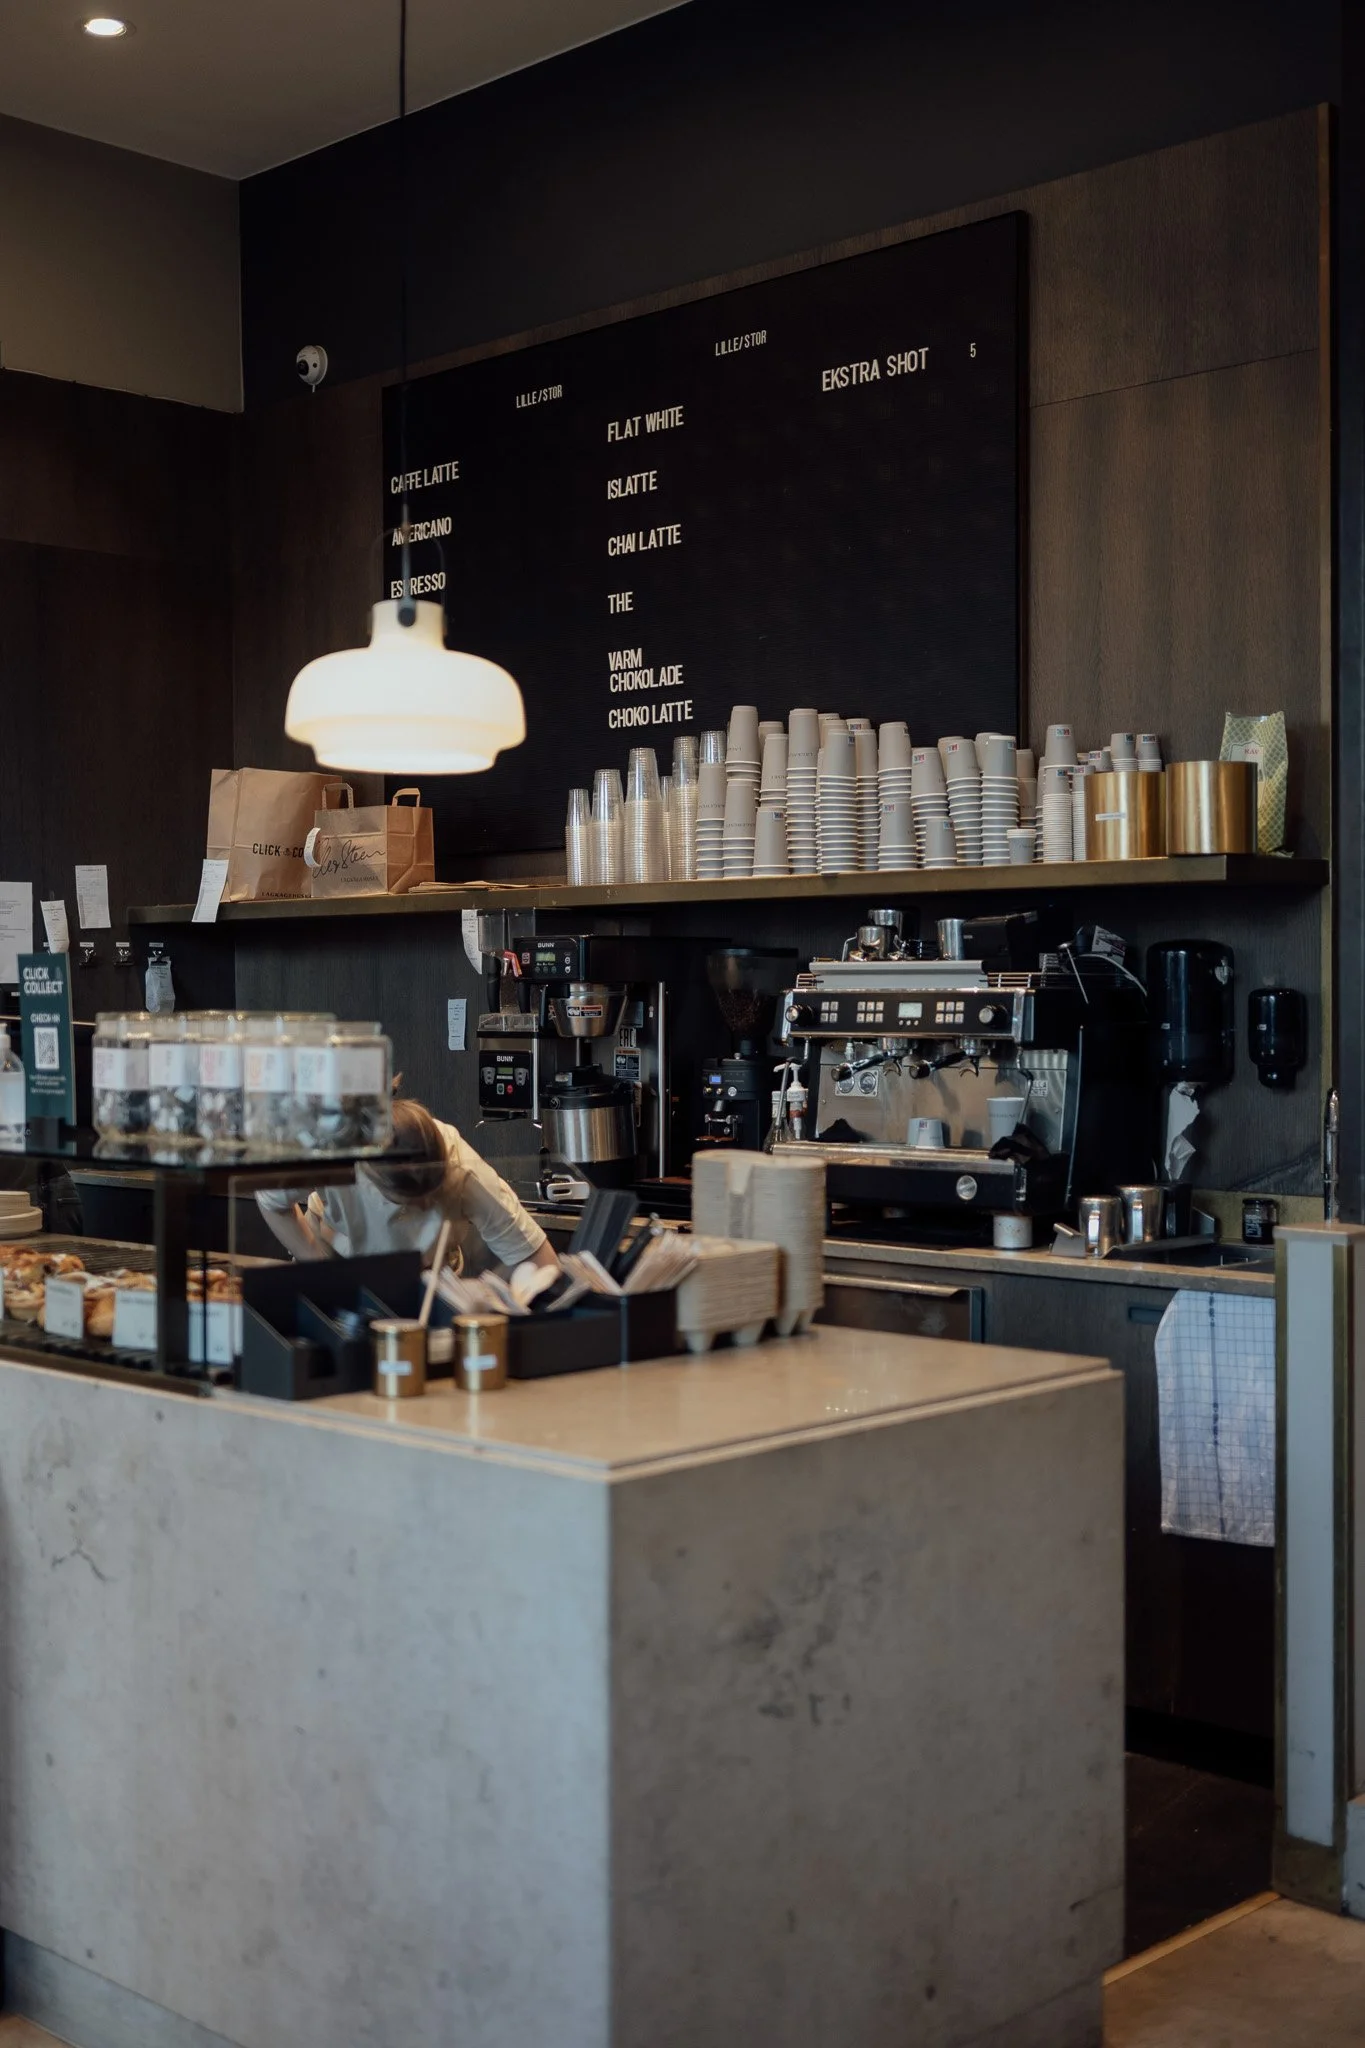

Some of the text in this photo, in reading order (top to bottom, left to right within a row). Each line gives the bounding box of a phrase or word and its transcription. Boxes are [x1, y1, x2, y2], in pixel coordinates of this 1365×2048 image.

[715, 330, 767, 356] LILLE/STOR
[970, 343, 977, 358] 5
[822, 347, 929, 392] EKSTRA SHOT
[516, 384, 563, 409] LILLE/STOR
[607, 405, 684, 443] FLAT WHITE
[390, 461, 460, 494] CAFFE LATTE
[607, 470, 658, 500] ISLATTE
[608, 523, 682, 557] CHAI LATTE
[390, 571, 446, 599] ESRESSO
[607, 591, 634, 614] THE
[608, 647, 642, 672] VARM
[609, 664, 684, 693] CHOKOLADE
[608, 699, 694, 729] CHOKO LATTE
[252, 843, 281, 857] CLICK
